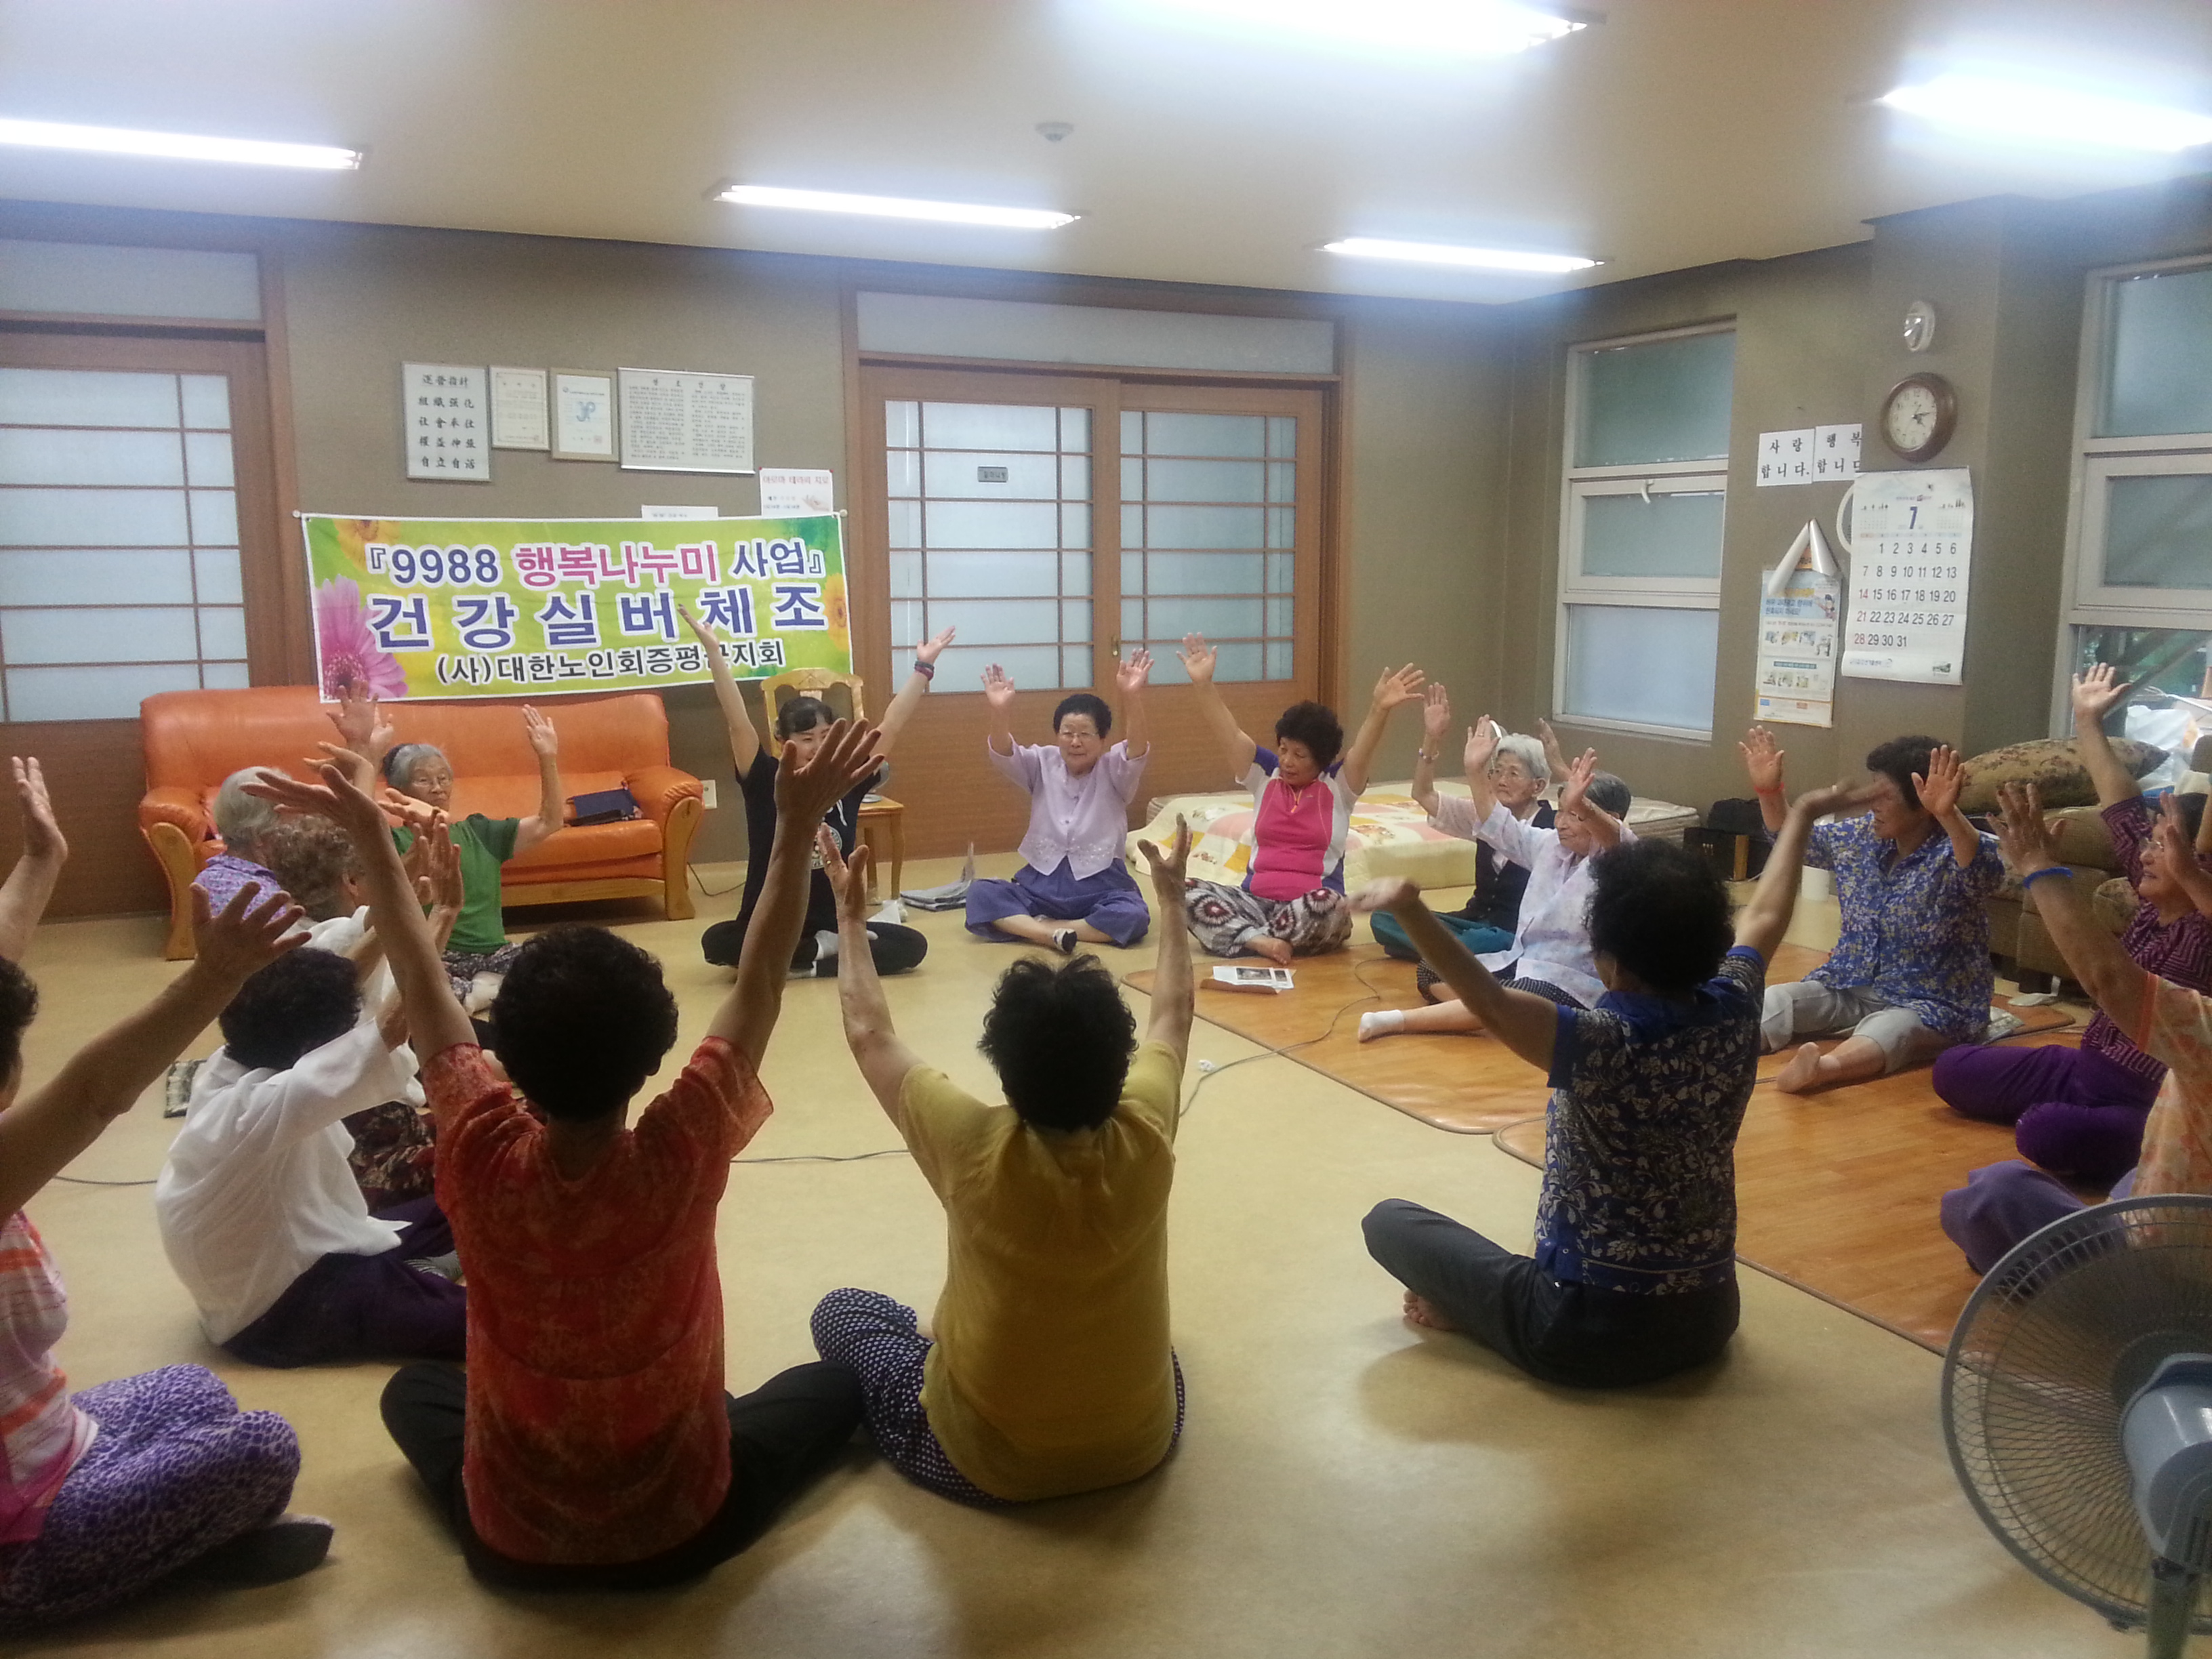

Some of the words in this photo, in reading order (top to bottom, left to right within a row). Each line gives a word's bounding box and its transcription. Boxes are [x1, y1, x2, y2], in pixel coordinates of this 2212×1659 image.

[1769, 438, 1803, 454] 사랑
[1826, 432, 1862, 448] 행복
[1761, 462, 1809, 478] 합니다.
[1910, 506, 1918, 529] 7
[1880, 543, 1883, 554] 1
[1893, 543, 1899, 554] 2
[1908, 542, 1913, 554] 3
[1921, 543, 1927, 554] 4
[1936, 543, 1942, 554] 5
[1950, 543, 1956, 554] 6
[516, 544, 717, 587] 행복나누미
[1863, 566, 1868, 576] 7
[1877, 566, 1882, 577] 8
[1891, 566, 1897, 577] 9
[1904, 566, 1913, 577] 10
[1919, 567, 1926, 577] 11
[1932, 567, 1942, 578] 12
[1946, 567, 1957, 579] 13
[1860, 589, 1868, 598] 14
[1873, 589, 1882, 600] 15
[1887, 589, 1896, 600] 16
[1902, 590, 1910, 600] 17
[1915, 590, 1925, 601] 18
[1930, 590, 1940, 602] 19
[1944, 590, 1956, 602] 20
[1857, 611, 1866, 622] 21
[1870, 611, 1881, 623] 22
[1883, 612, 1895, 623] 23
[1898, 613, 1909, 623] 24
[1912, 613, 1924, 625] 25
[1927, 613, 1939, 626] 26
[1942, 614, 1954, 626] 27
[1854, 633, 1865, 644] 28
[1868, 634, 1879, 645] 29
[1882, 635, 1893, 647] 30
[1897, 636, 1906, 647] 31
